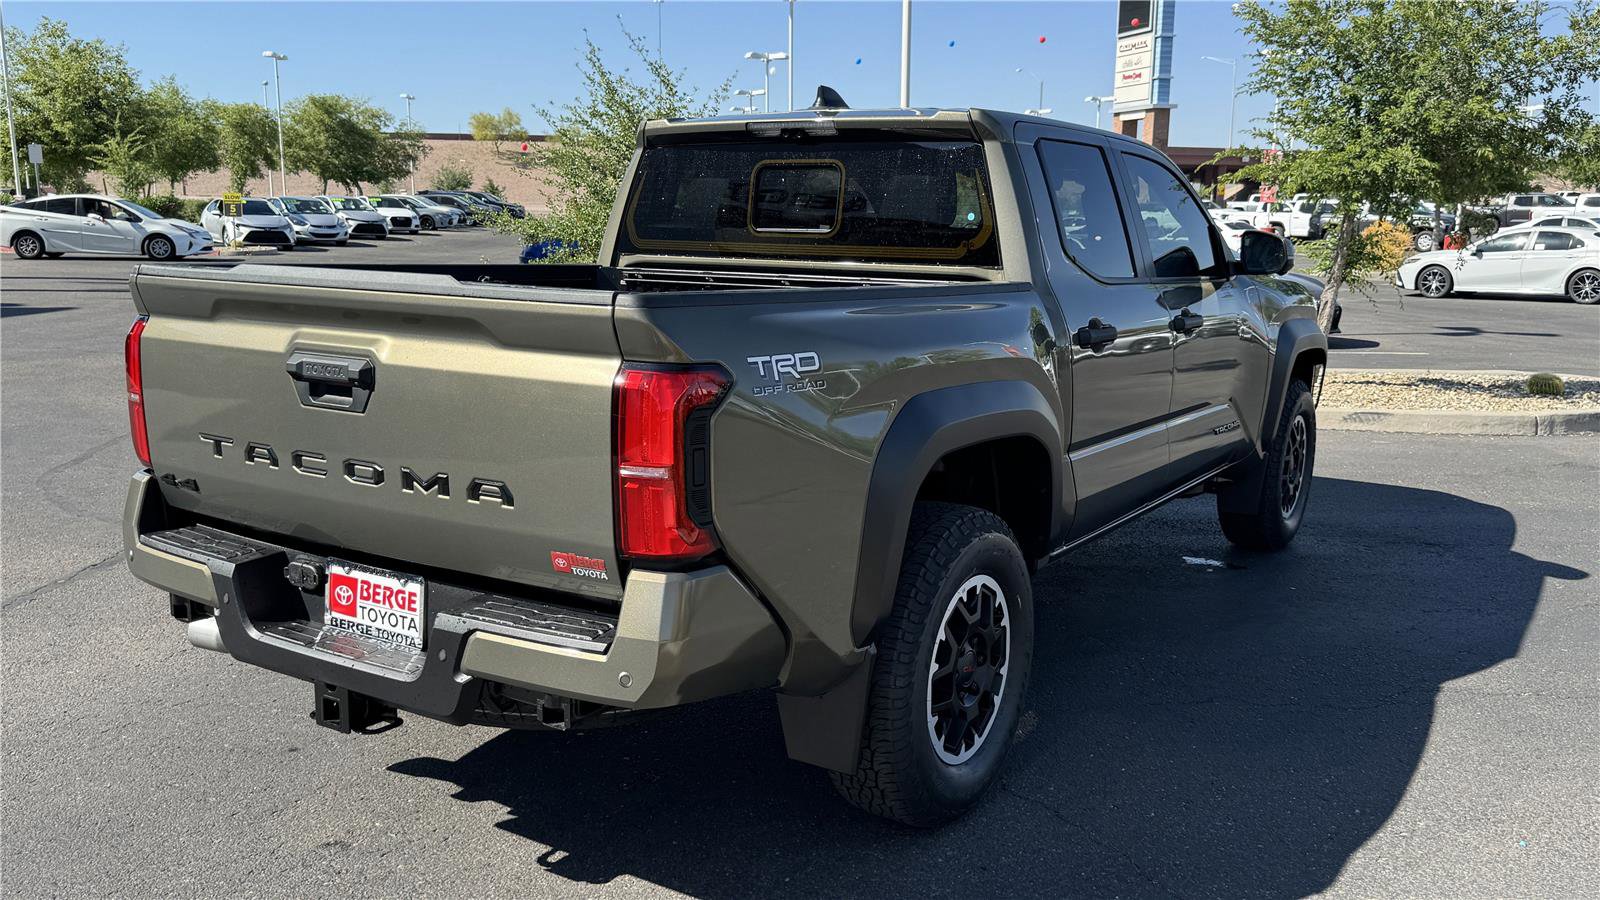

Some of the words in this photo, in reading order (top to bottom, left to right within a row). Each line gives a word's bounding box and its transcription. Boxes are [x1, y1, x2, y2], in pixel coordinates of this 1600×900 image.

[230, 204, 237, 212] 5
[305, 363, 346, 378] TOYOTA
[747, 351, 820, 380] TRD
[753, 385, 783, 397] OFF
[786, 379, 827, 394] ROAD
[199, 432, 514, 509] TACOMA
[571, 567, 608, 581] TOYOTA
[360, 580, 417, 612] BERGE
[330, 617, 373, 635] BERGE
[374, 628, 416, 647] TOYOTA
[359, 605, 418, 632] TOYOTA
